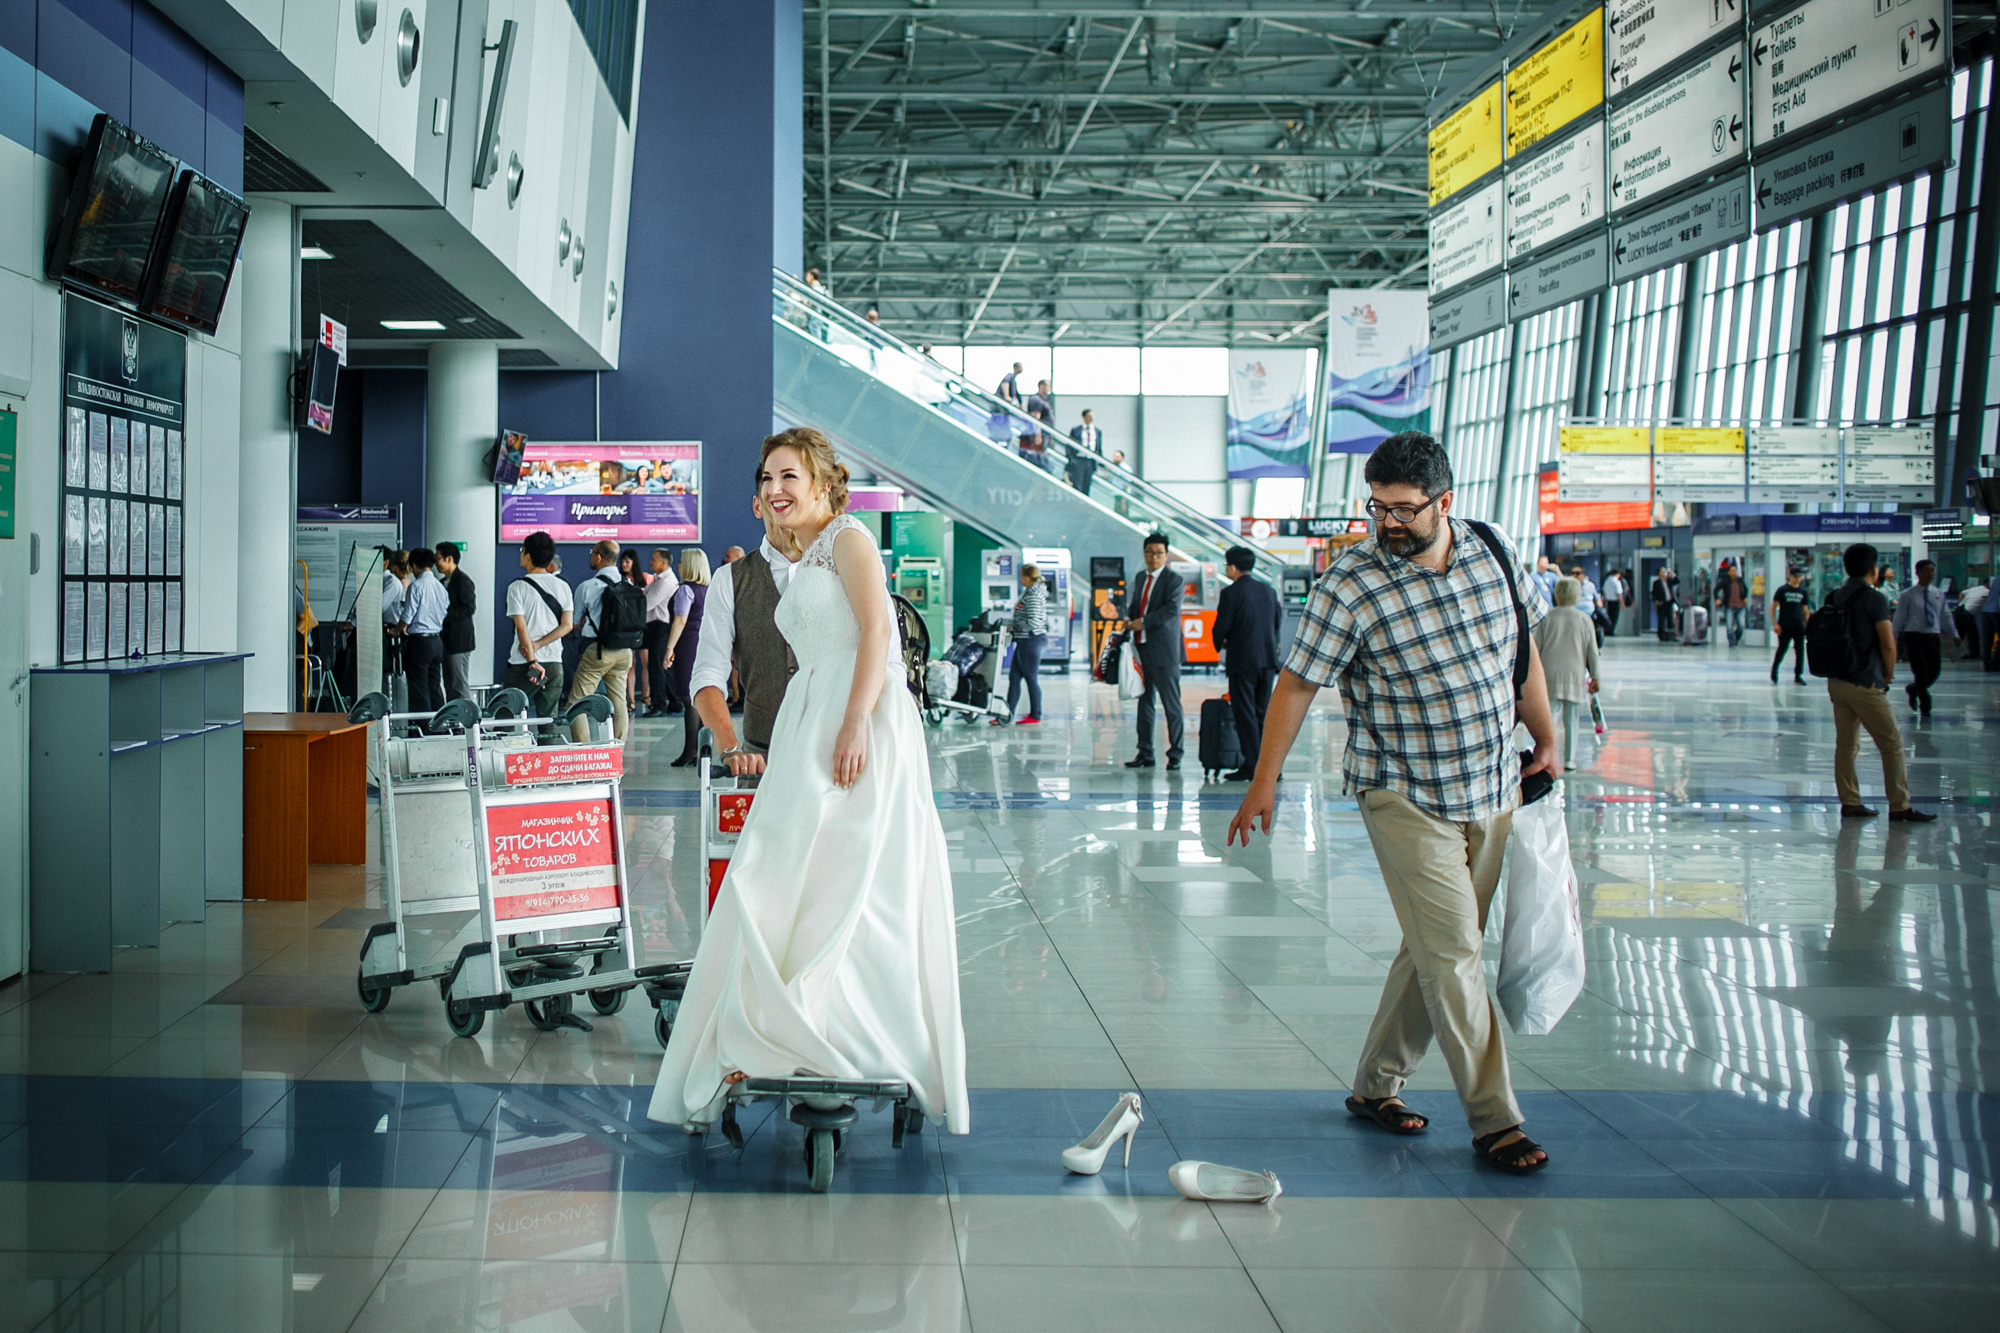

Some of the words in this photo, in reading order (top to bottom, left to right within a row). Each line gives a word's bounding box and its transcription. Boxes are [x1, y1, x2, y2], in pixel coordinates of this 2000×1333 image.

[1770, 12, 1804, 41] Туалеты
[1620, 34, 1646, 58] Полиция
[1770, 36, 1796, 60] Toilets
[1620, 56, 1637, 74] Police
[1772, 56, 1829, 98] Медицинский
[1831, 45, 1857, 71] пункт
[1611, 122, 1627, 136] Service
[1644, 100, 1664, 118] disabled
[1666, 89, 1686, 110] persons
[1773, 100, 1790, 118] First
[1792, 89, 1806, 108] Aid
[1624, 146, 1661, 172] Информация
[1774, 160, 1806, 183] Упаковка
[1808, 150, 1834, 170] багажа
[1540, 167, 1550, 182] Child
[1552, 161, 1564, 175] room
[1624, 164, 1655, 188] Information
[1657, 156, 1671, 172] desk
[1774, 185, 1804, 206] Baggage
[1806, 173, 1834, 197] packing
[1537, 216, 1554, 230] Control
[1628, 232, 1640, 243] Зона
[1641, 220, 1666, 239] быстрого
[1667, 210, 1690, 228] питания
[1628, 246, 1646, 263] LUCKY
[1646, 242, 1658, 256] food
[1659, 237, 1673, 251] court
[1539, 282, 1548, 295] Post
[1549, 280, 1559, 292] office
[78, 382, 121, 402] ВЛАДИВОСТОКСКАЯ
[124, 394, 144, 408] ТАМОЖНЯ
[146, 400, 174, 415] ИНФОРМИРУЕТ
[571, 502, 628, 520] Приморье
[1308, 520, 1350, 532] LUCKY
[548, 766, 559, 774] ДО
[560, 764, 583, 773] СДАЧИ
[584, 762, 612, 771] БАГАЖА!
[550, 754, 587, 763] ЗАГЛЯНИТЕ
[469, 765, 478, 786] 084
[522, 817, 573, 828] МАГАЗИНЧИК
[495, 828, 600, 852] ЯПОНСКИХ
[523, 853, 577, 868] ТОВАРОВ
[499, 874, 543, 884] МЕЖДУНАРОДНЫЙ
[571, 870, 604, 878] ВЛАДИВОСТОК
[525, 894, 589, 908] 8(914)790-35-56
